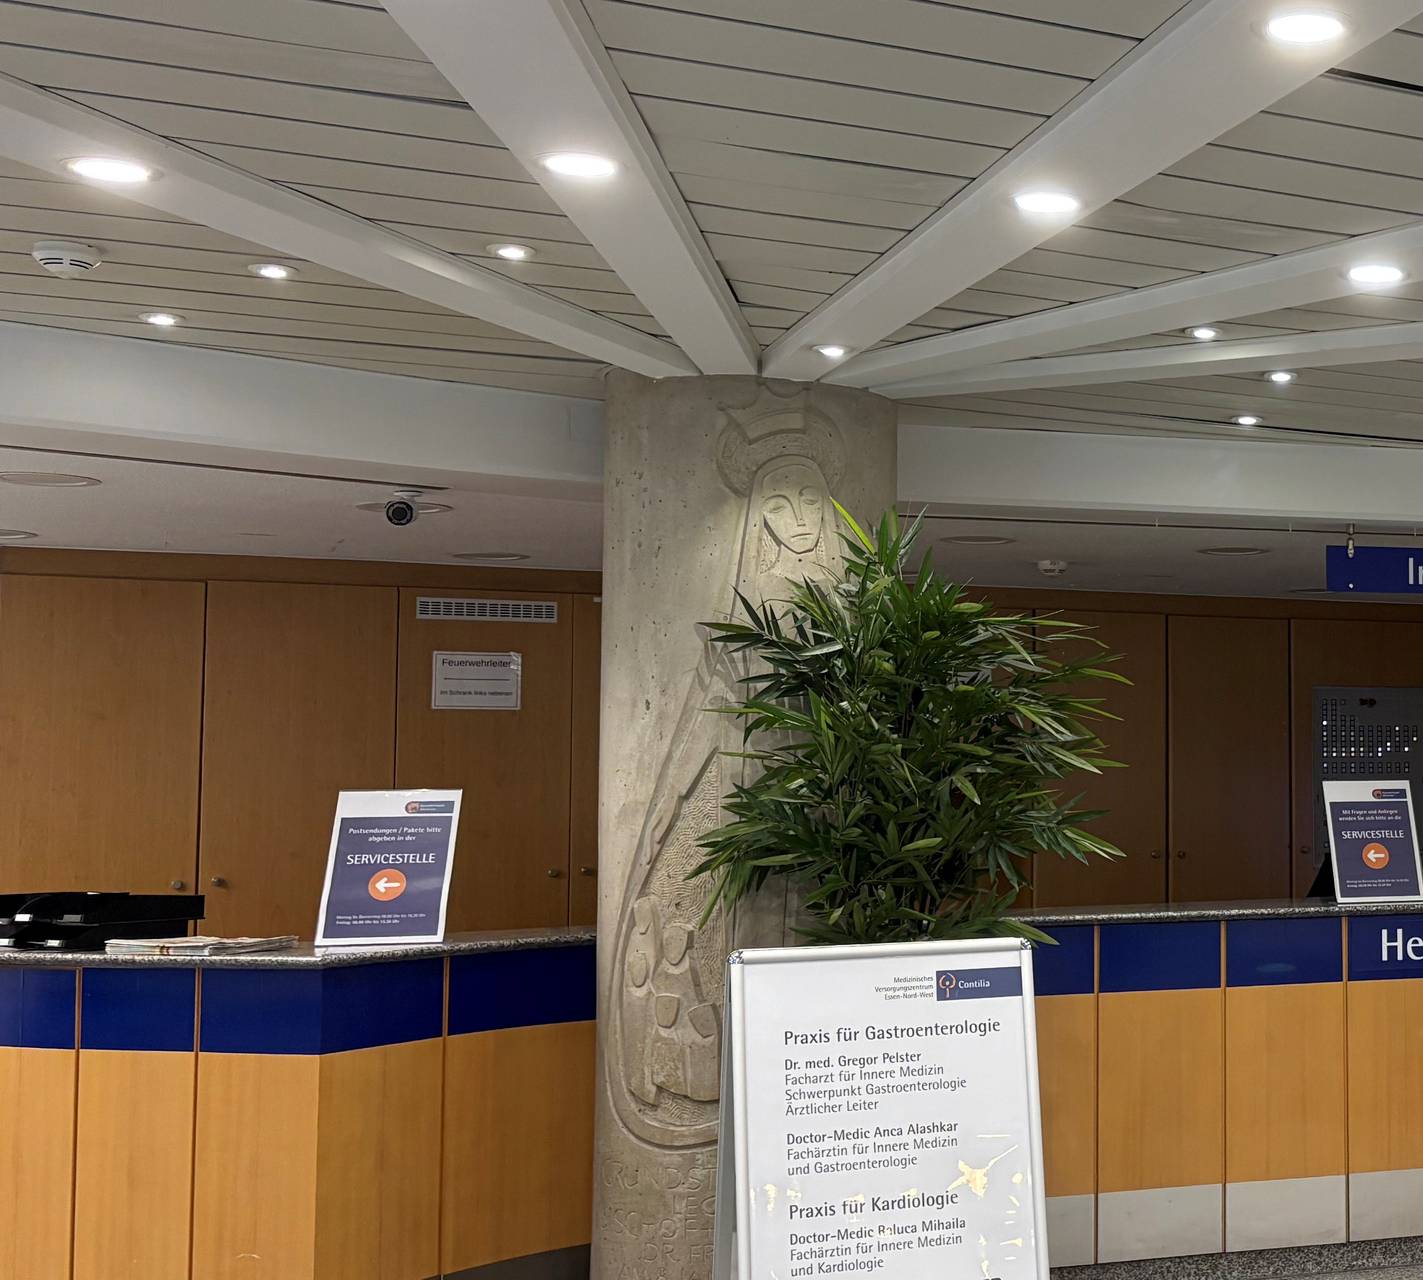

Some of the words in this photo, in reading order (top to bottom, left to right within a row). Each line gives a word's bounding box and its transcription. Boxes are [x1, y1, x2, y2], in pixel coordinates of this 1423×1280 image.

[442, 658, 511, 667] Feuerwehrleiter
[1342, 830, 1404, 839] SERVICESTELLE
[346, 853, 436, 865] SERVICESTELLE
[885, 992, 933, 1000] Essen-Nord-West
[958, 980, 990, 989] Contilia
[784, 1028, 830, 1045] Praxis
[836, 1025, 860, 1042] für
[864, 1018, 1001, 1041] Gastroenterologie
[785, 1058, 801, 1071] Dr.
[805, 1055, 834, 1069] med.
[838, 1053, 878, 1070] Gregor
[882, 1050, 922, 1064] Pelster
[785, 1071, 835, 1086] Facharzt
[838, 1069, 856, 1083] für
[859, 1067, 896, 1081] Innere
[899, 1063, 944, 1078] Medizin
[785, 1085, 862, 1103] Schwerpunkt
[865, 1077, 967, 1096] Gastroenterologie
[785, 1099, 842, 1116] Ärztlicher
[846, 1098, 879, 1112] Leiter
[787, 1127, 871, 1145] Doctor-Medic
[873, 1125, 903, 1138] Anca
[907, 1121, 958, 1136] Alashkar
[787, 1144, 848, 1161] Fachärztin
[852, 1143, 870, 1156] für
[873, 1140, 910, 1154] Innere
[913, 1136, 958, 1152] Medizin
[787, 1163, 810, 1176] und
[814, 1153, 918, 1174] Gastroenterologie
[789, 1203, 836, 1220] Praxis
[842, 1200, 865, 1216] für
[871, 1190, 959, 1212] Kardiologie
[789, 1226, 874, 1245] Doctor-Medic
[921, 1216, 966, 1233] Mihaila
[790, 1244, 852, 1261] Fachärztin
[855, 1240, 875, 1256] für
[877, 1238, 914, 1252] Innere
[917, 1233, 962, 1249] Medizin
[791, 1263, 814, 1277] und
[817, 1256, 884, 1274] Kardiologie
